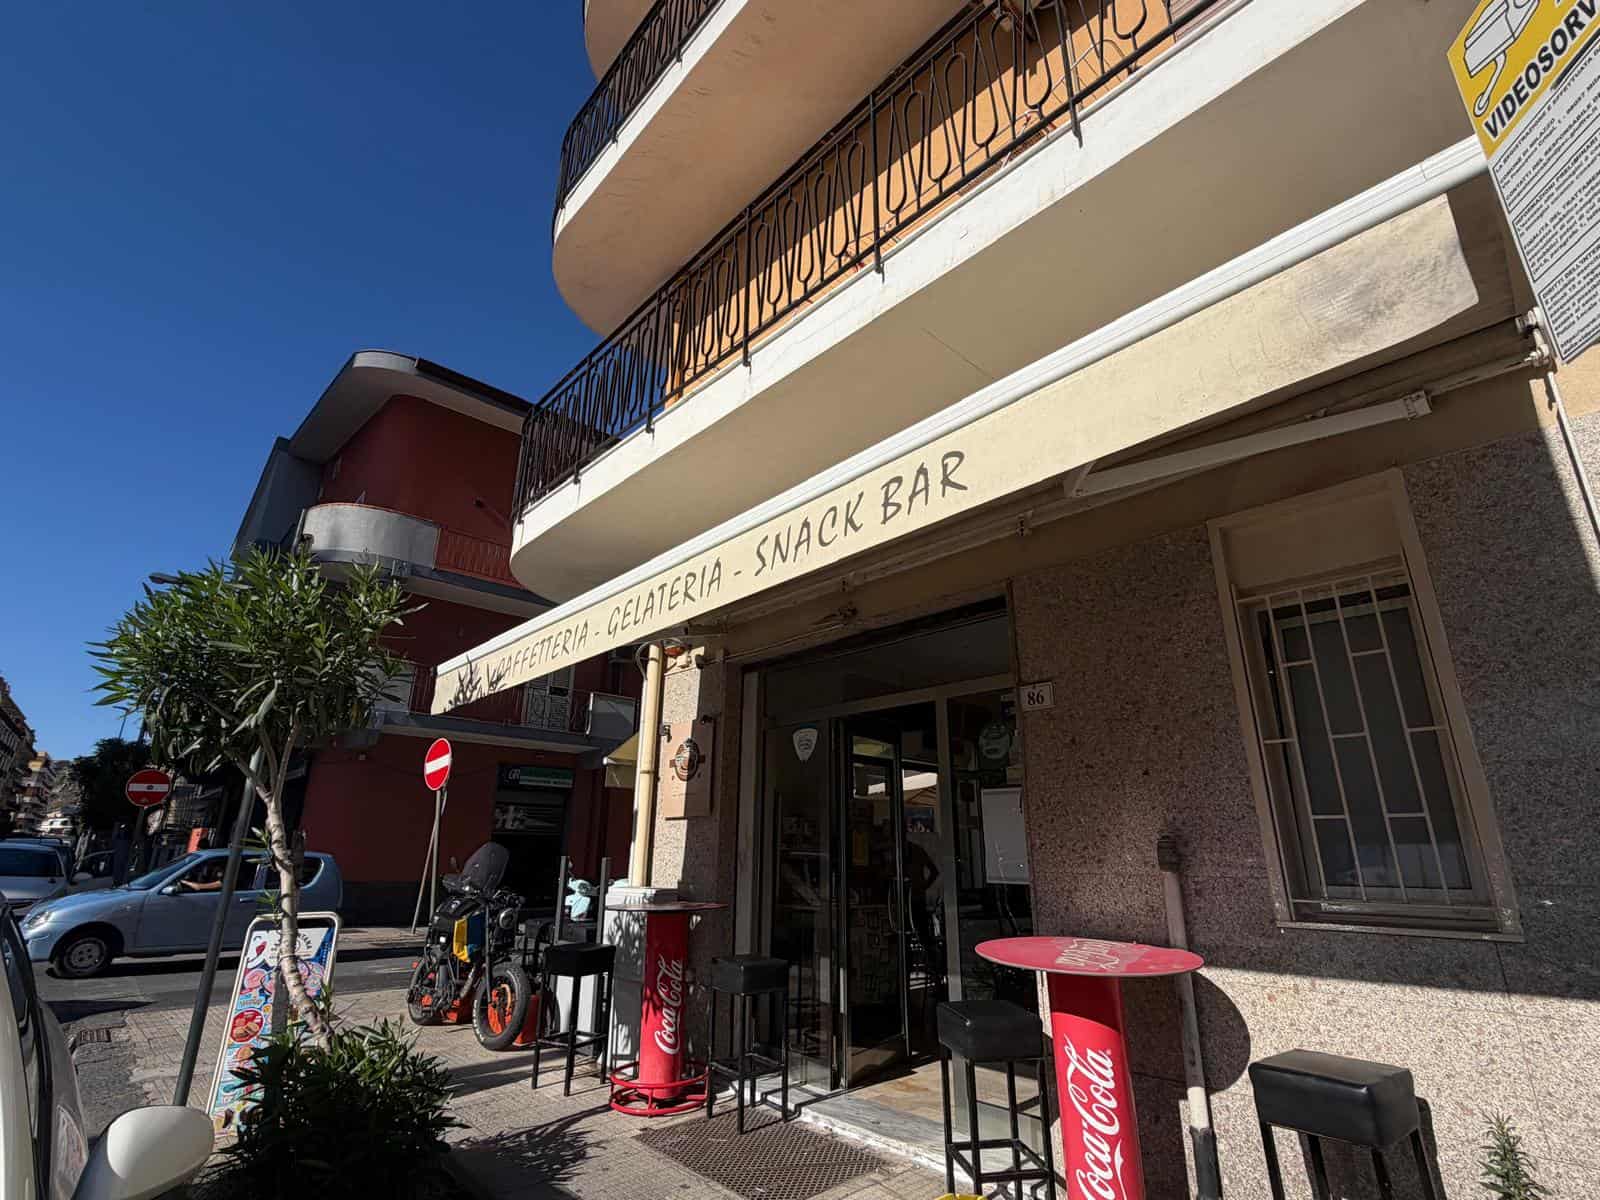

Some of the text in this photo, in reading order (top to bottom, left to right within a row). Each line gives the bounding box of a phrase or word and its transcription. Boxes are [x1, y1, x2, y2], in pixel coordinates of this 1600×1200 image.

[607, 556, 722, 639] GELATERIA
[754, 491, 864, 577] SNACK
[880, 451, 968, 525] BAR
[1027, 689, 1045, 705] 86
